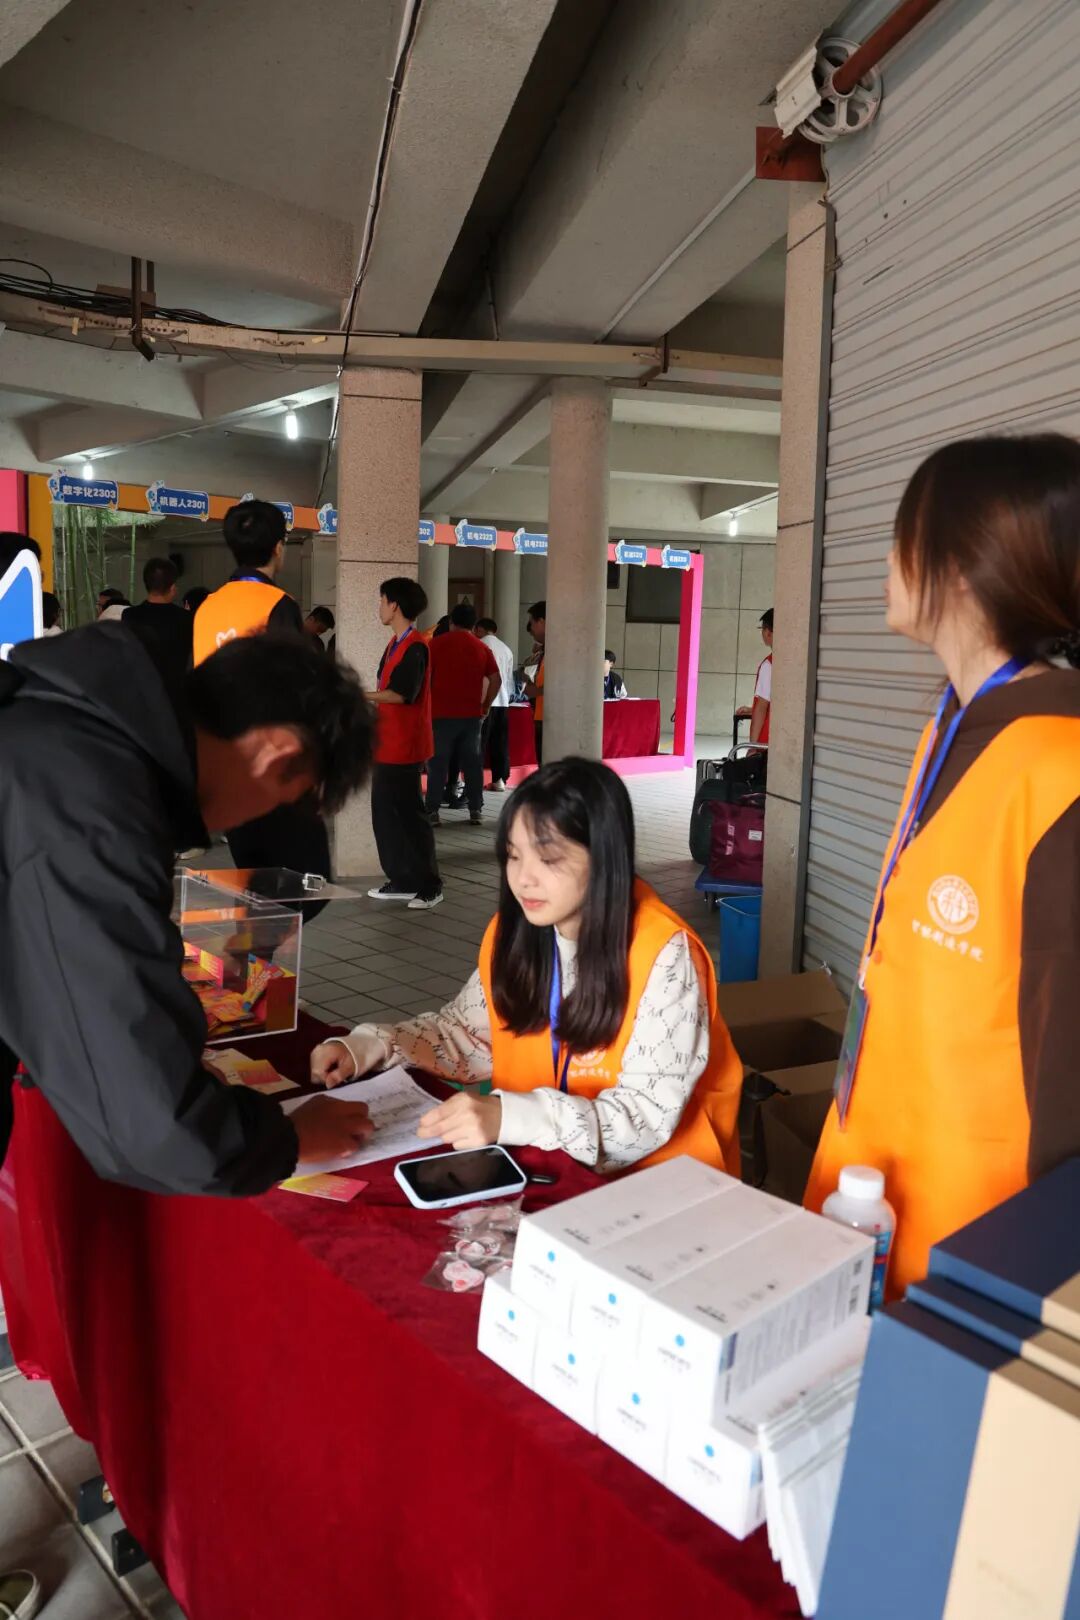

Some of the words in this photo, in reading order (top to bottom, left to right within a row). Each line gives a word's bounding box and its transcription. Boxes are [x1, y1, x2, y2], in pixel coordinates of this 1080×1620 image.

[62, 484, 116, 499] 数字化2303
[159, 496, 206, 509] 机器人2301
